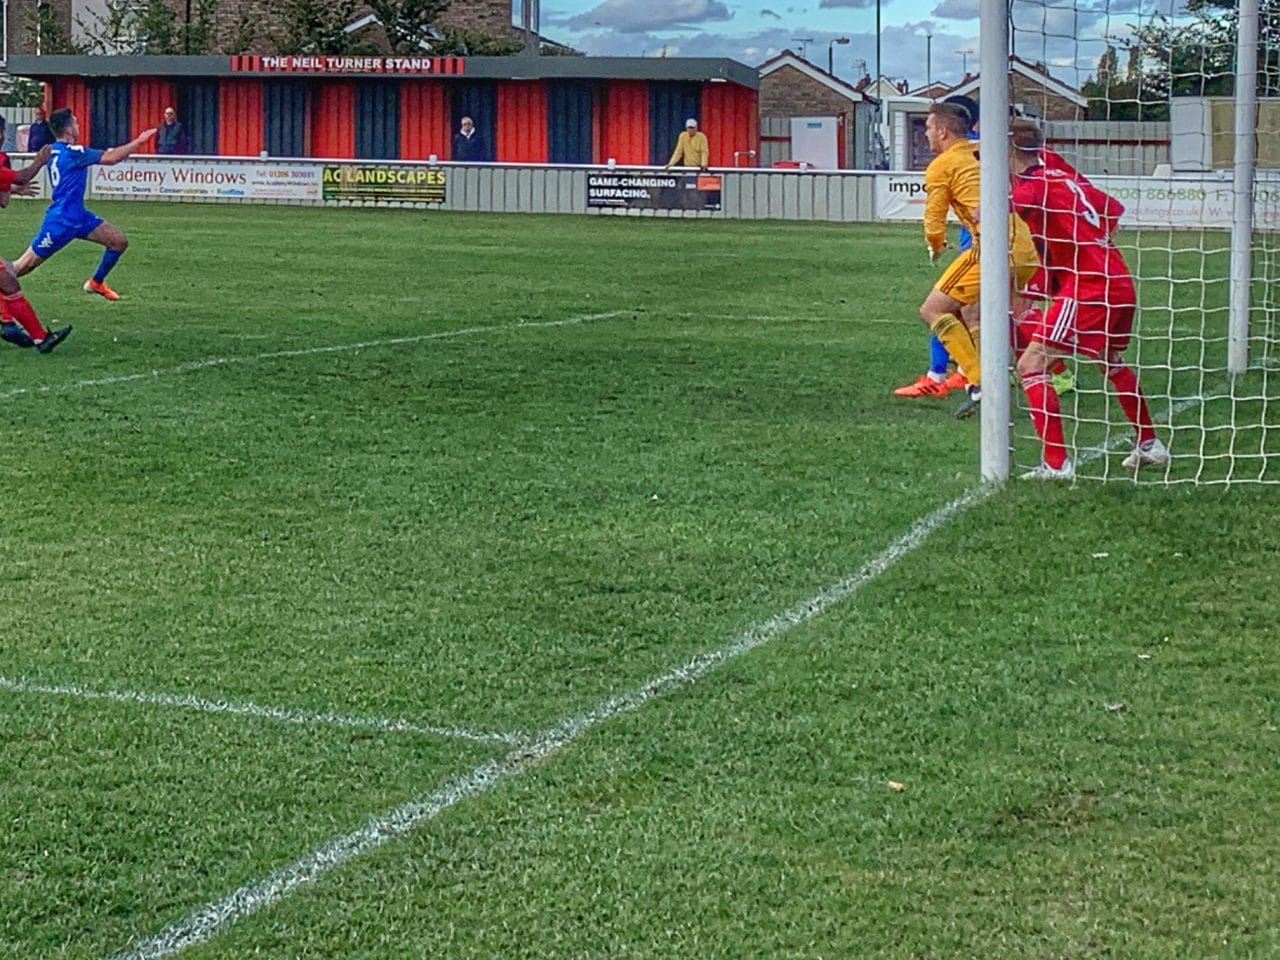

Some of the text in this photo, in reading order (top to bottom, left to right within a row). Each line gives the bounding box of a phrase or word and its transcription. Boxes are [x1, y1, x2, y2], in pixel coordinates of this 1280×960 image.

[262, 57, 431, 70] THE NEIL TURNER STAND
[96, 167, 247, 186] Academy Windows
[346, 168, 446, 185] LANDSCAPES
[589, 177, 677, 188] GAME-CHANGING
